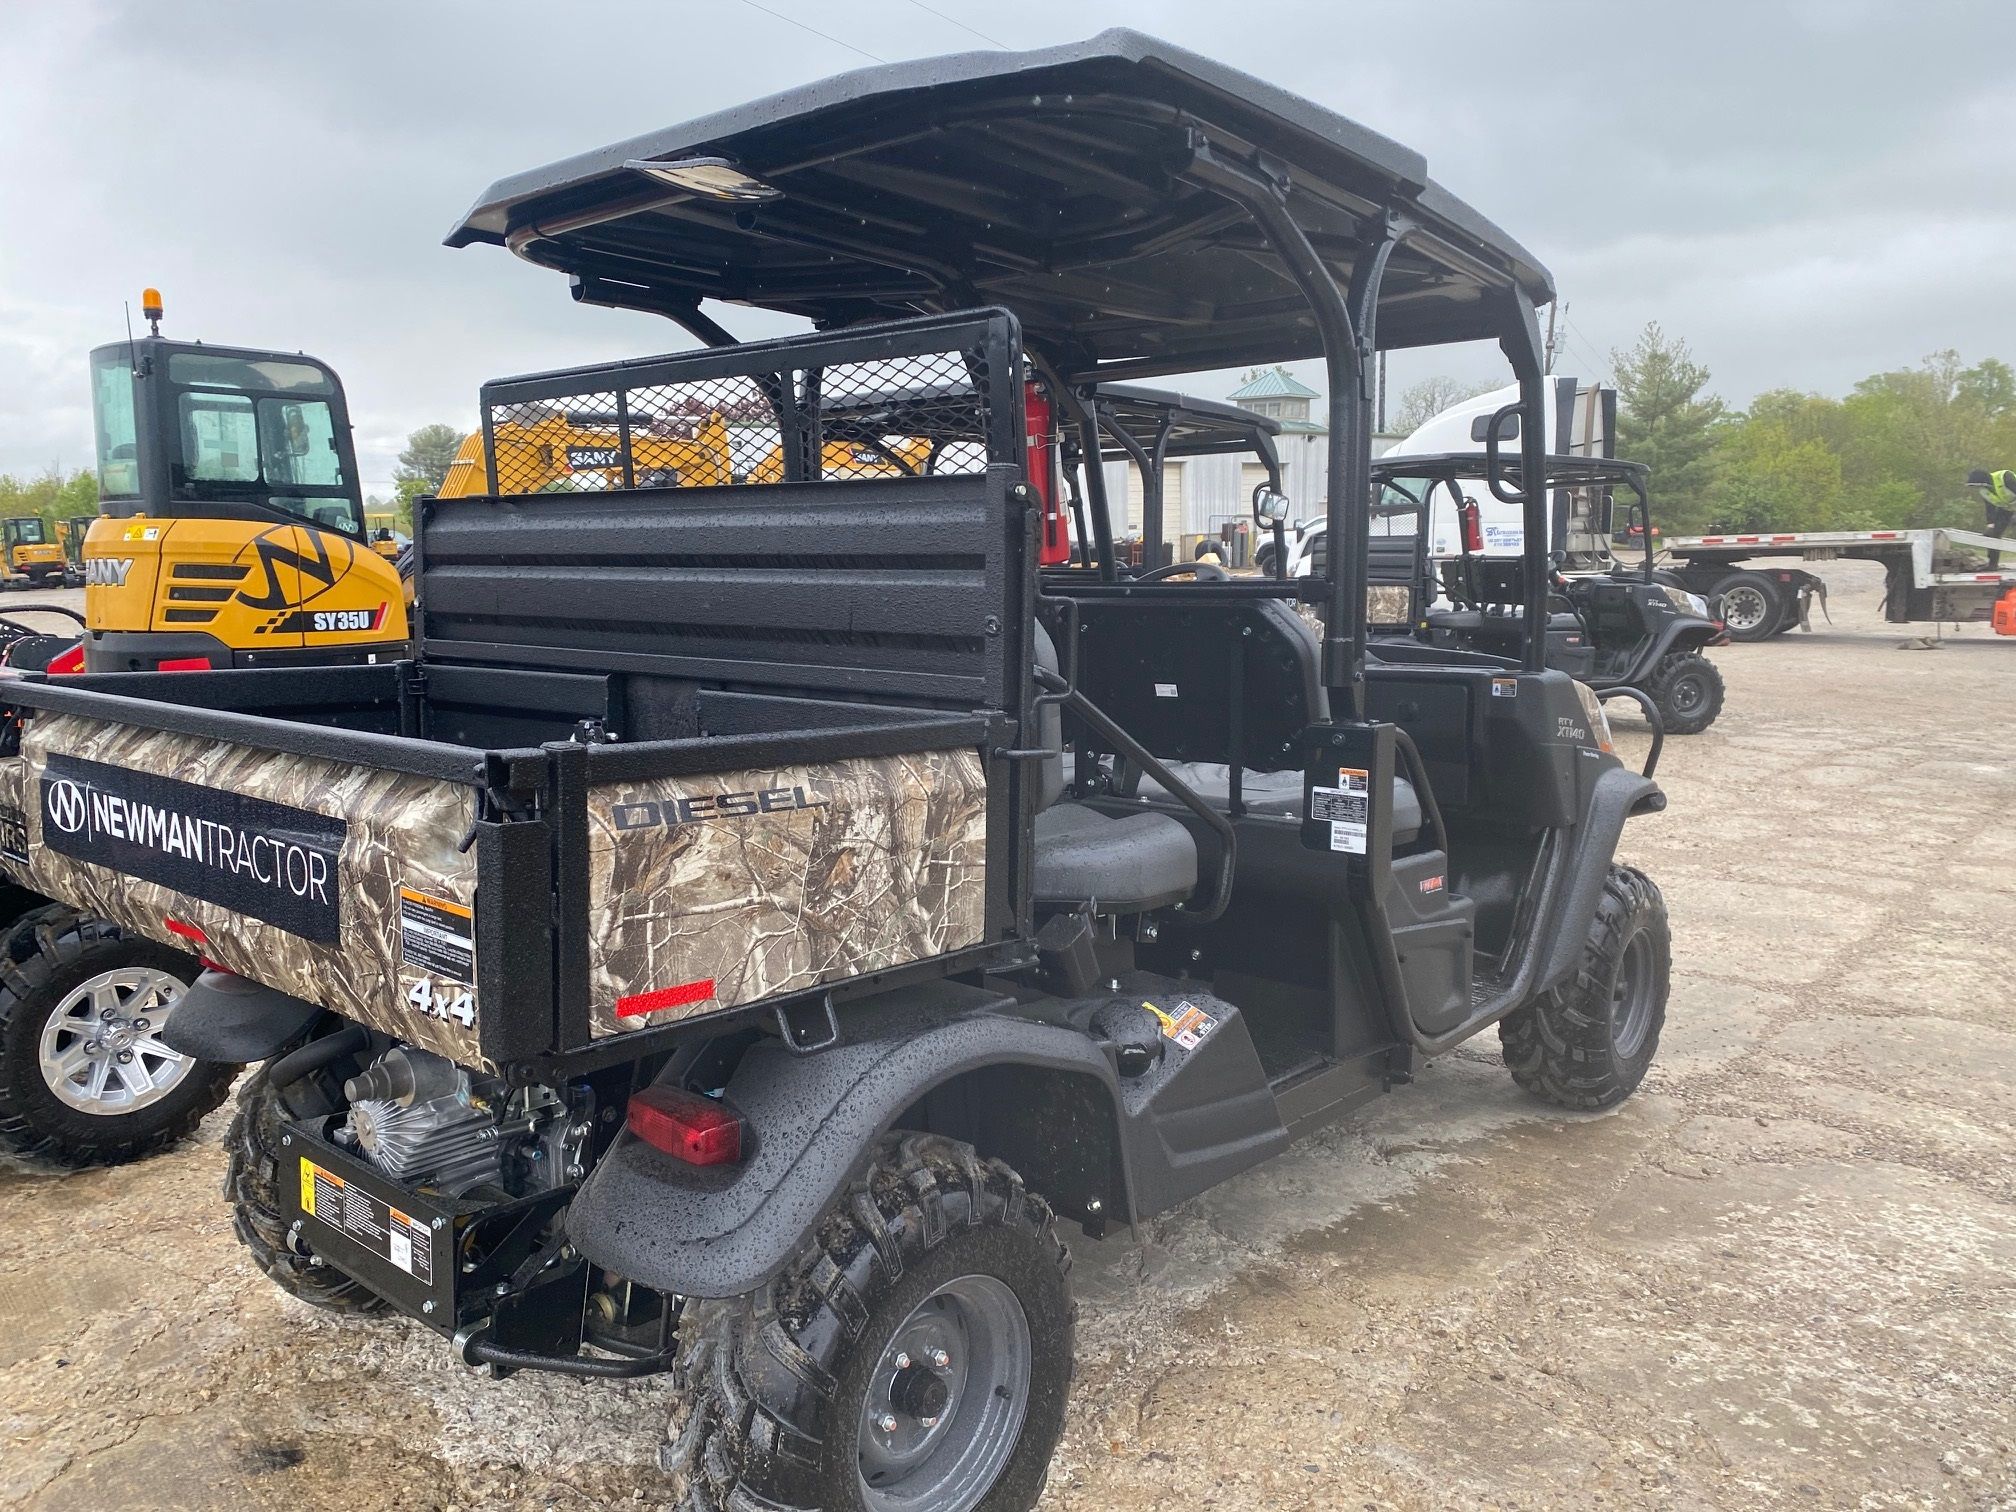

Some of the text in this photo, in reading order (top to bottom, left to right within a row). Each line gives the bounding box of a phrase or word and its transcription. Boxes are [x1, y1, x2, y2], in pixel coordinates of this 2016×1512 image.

[570, 451, 617, 465] SANY
[86, 558, 134, 586] ANY
[313, 611, 369, 631] SY35U
[611, 786, 831, 831] DIESEL
[409, 978, 476, 1028] 4x4
